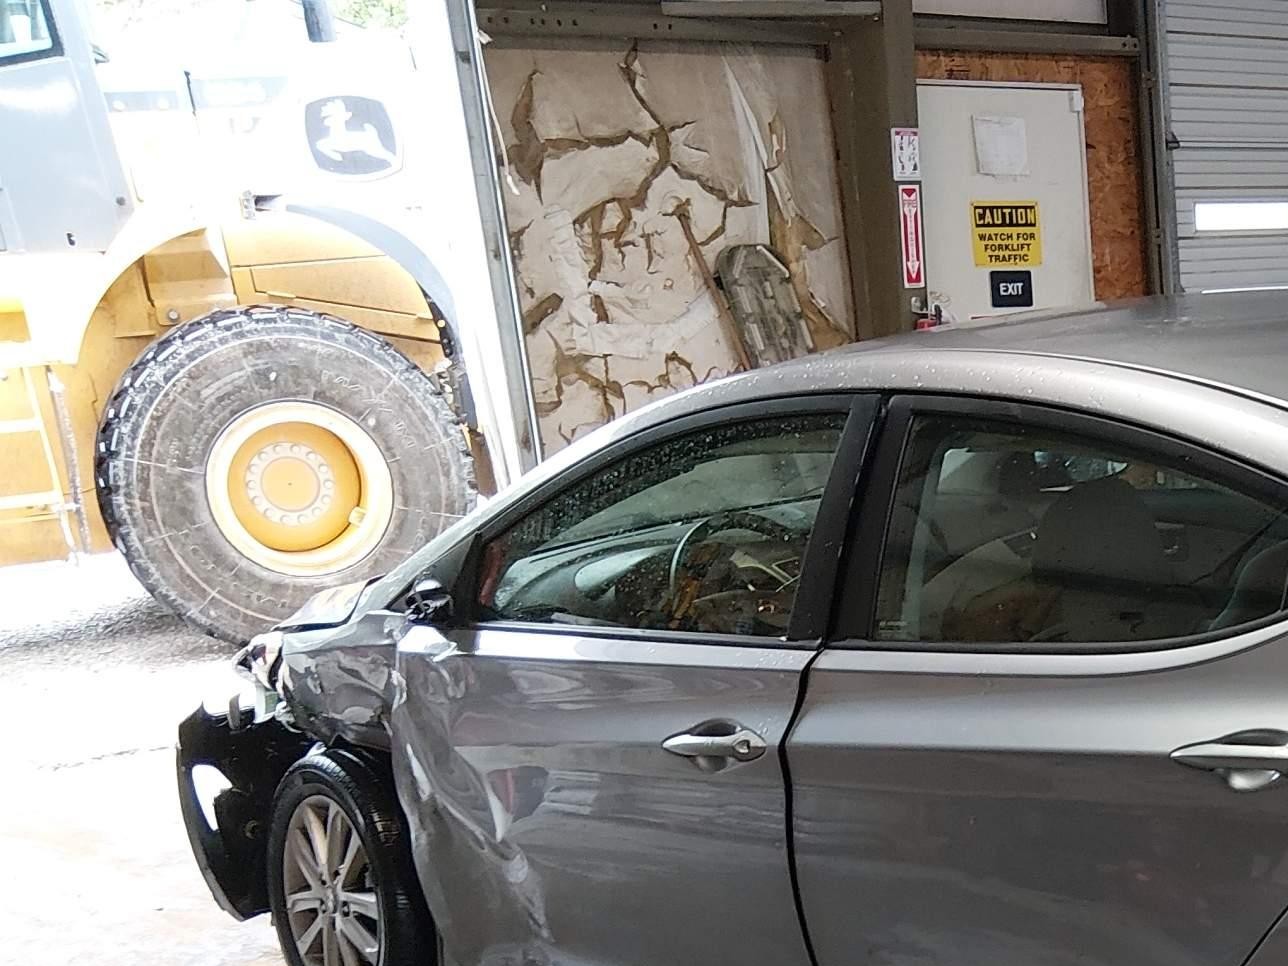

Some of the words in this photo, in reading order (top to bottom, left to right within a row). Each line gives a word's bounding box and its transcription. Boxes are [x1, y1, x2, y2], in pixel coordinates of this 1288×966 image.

[975, 207, 1036, 226] CAUTION
[978, 232, 1015, 242] WATCH
[1016, 232, 1036, 241] FOR
[984, 242, 1031, 252] FORKLIFT
[988, 253, 1030, 263] TRAFFIC
[999, 282, 1023, 296] EXIT
